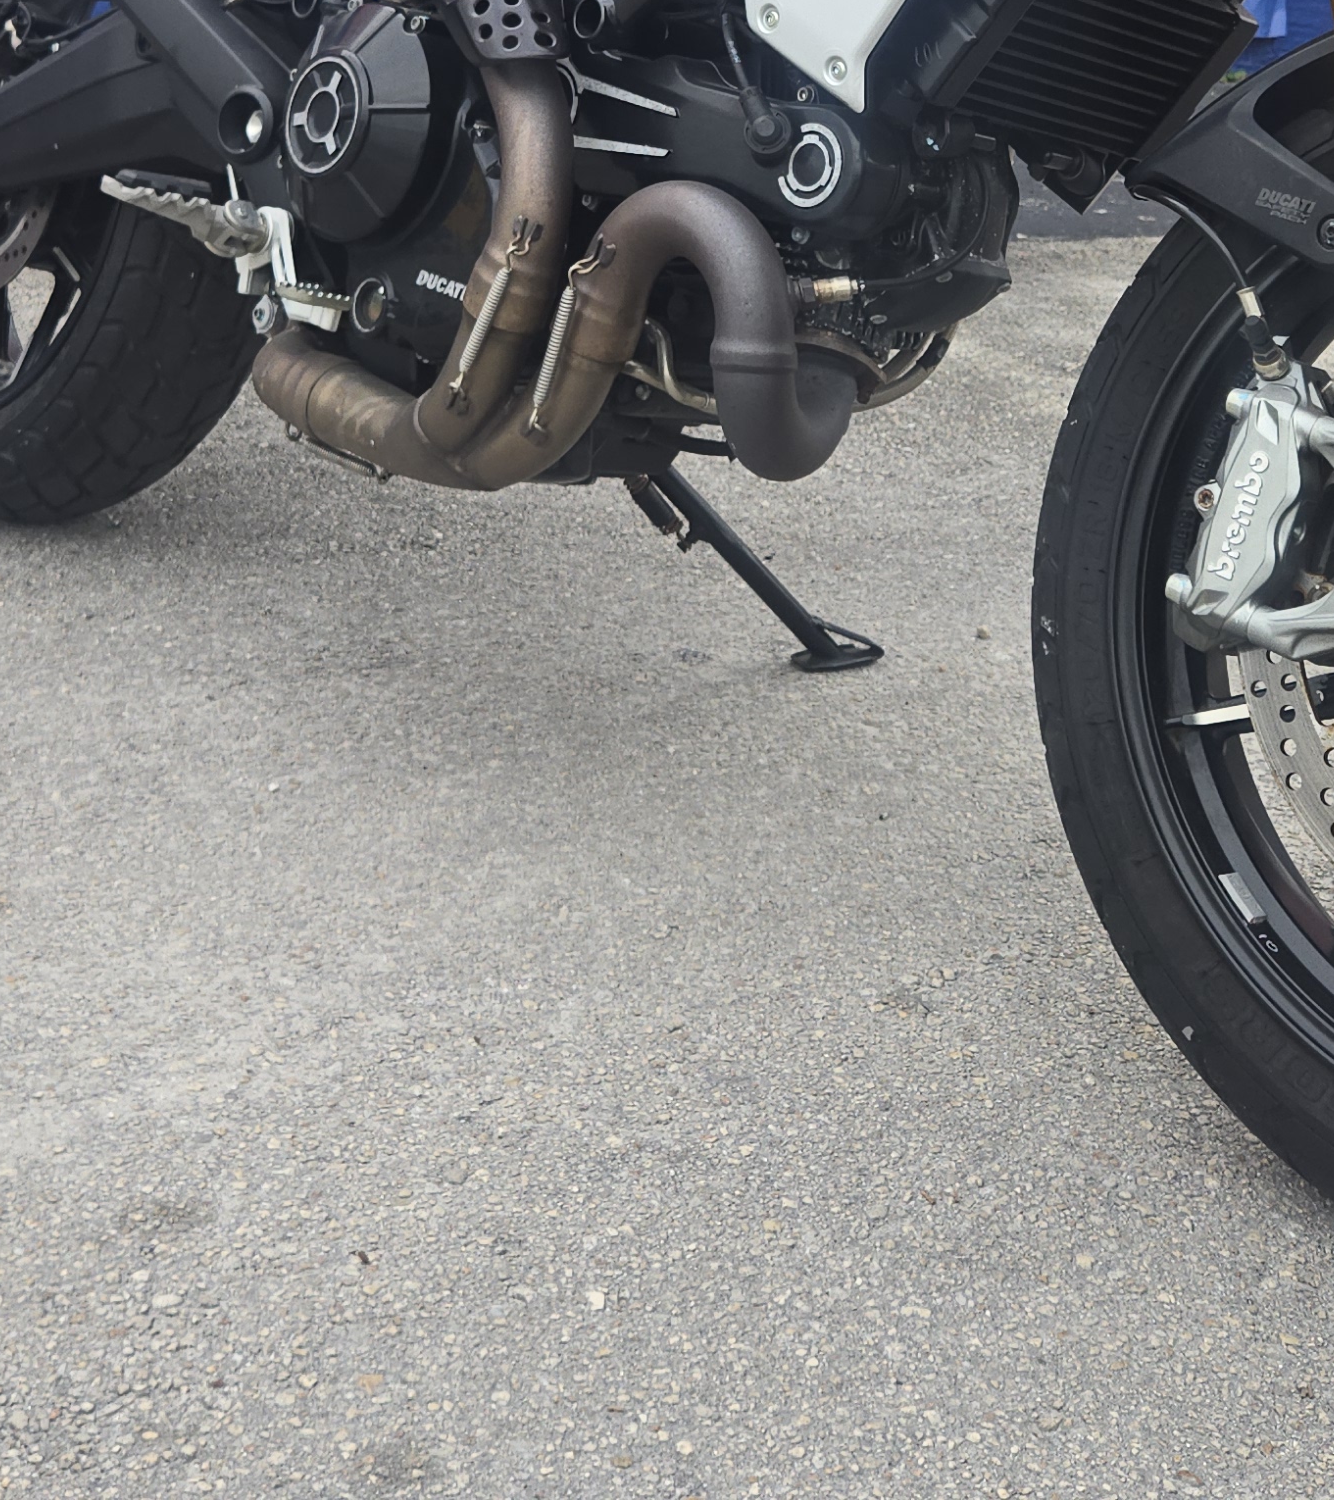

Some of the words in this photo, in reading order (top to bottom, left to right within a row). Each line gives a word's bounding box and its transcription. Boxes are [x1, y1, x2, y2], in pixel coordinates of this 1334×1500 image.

[1257, 187, 1316, 213] DUCATI
[415, 269, 467, 302] DUCATI
[1207, 450, 1270, 581] brembo
